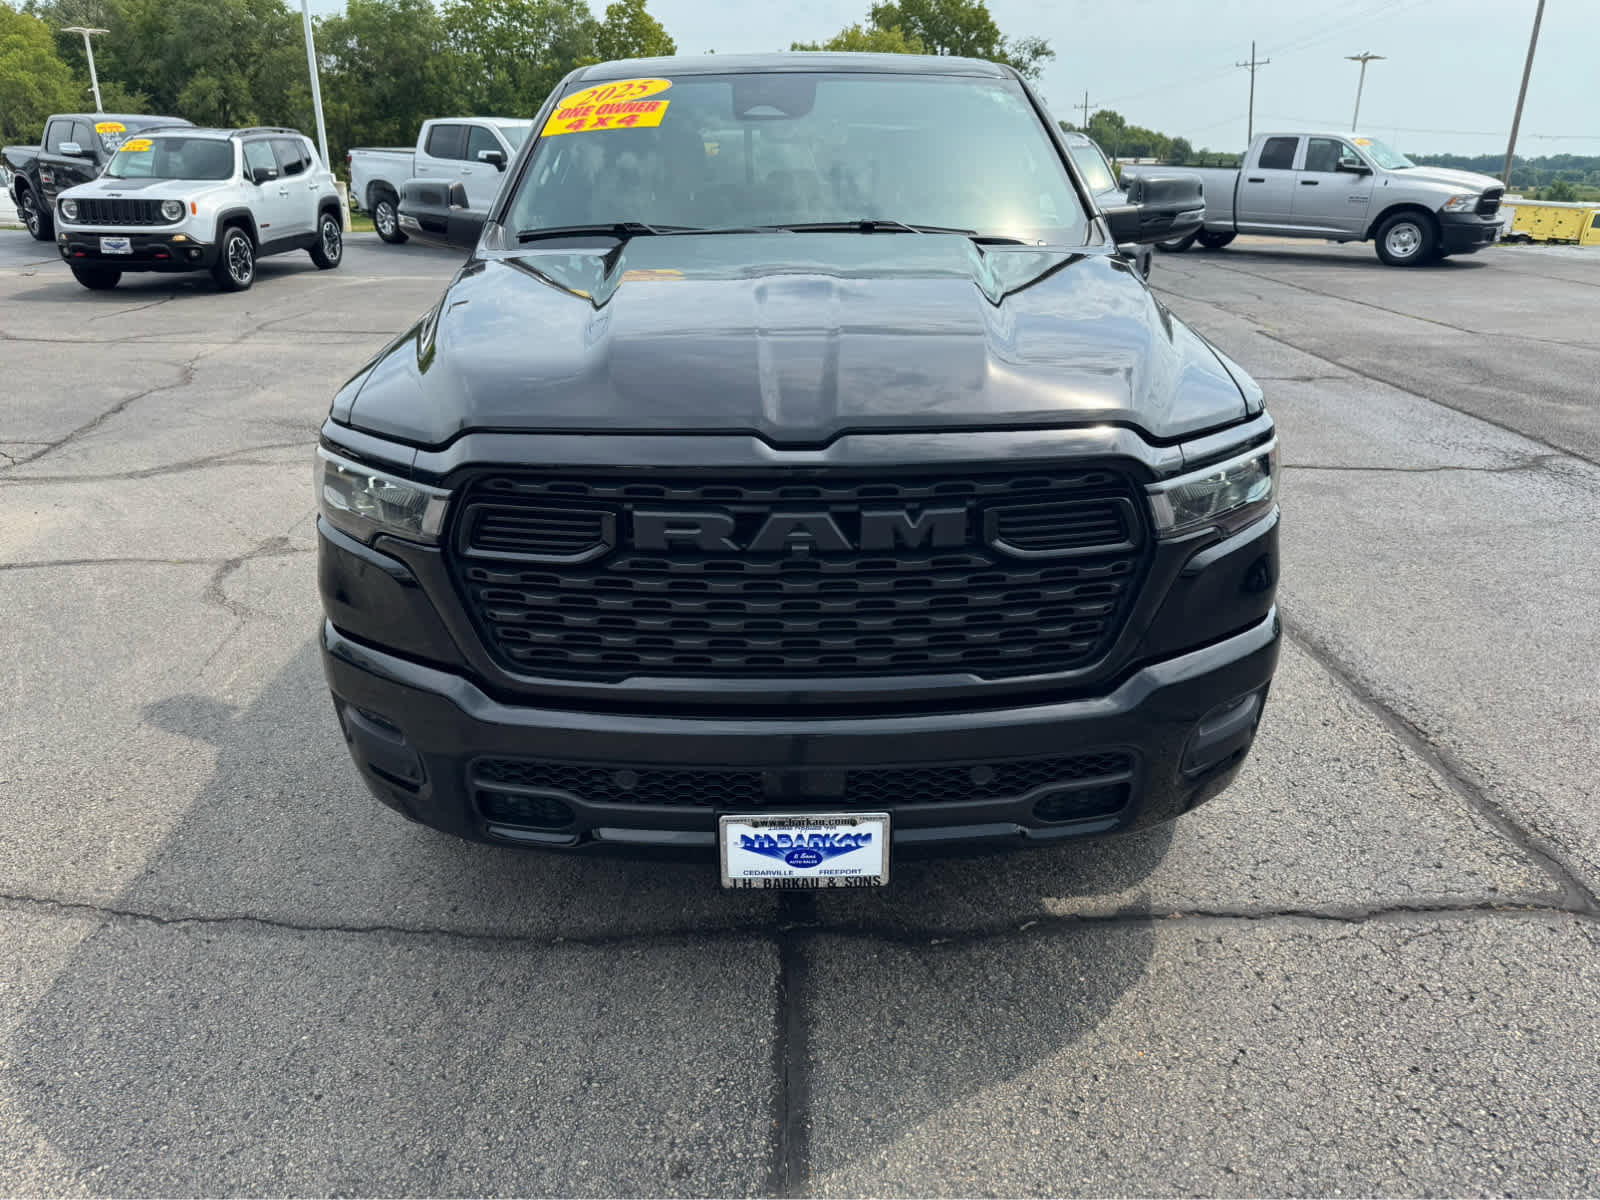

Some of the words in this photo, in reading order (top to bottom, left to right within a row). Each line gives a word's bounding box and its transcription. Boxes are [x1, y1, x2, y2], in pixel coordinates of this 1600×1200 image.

[577, 80, 655, 106] 2025
[557, 104, 595, 120] ONE
[595, 101, 661, 115] OWNER
[632, 508, 968, 551] RAM
[759, 817, 851, 827] www.barkau.com
[763, 878, 820, 889] BARKAU
[827, 876, 837, 889] &
[845, 875, 881, 888] SONS
